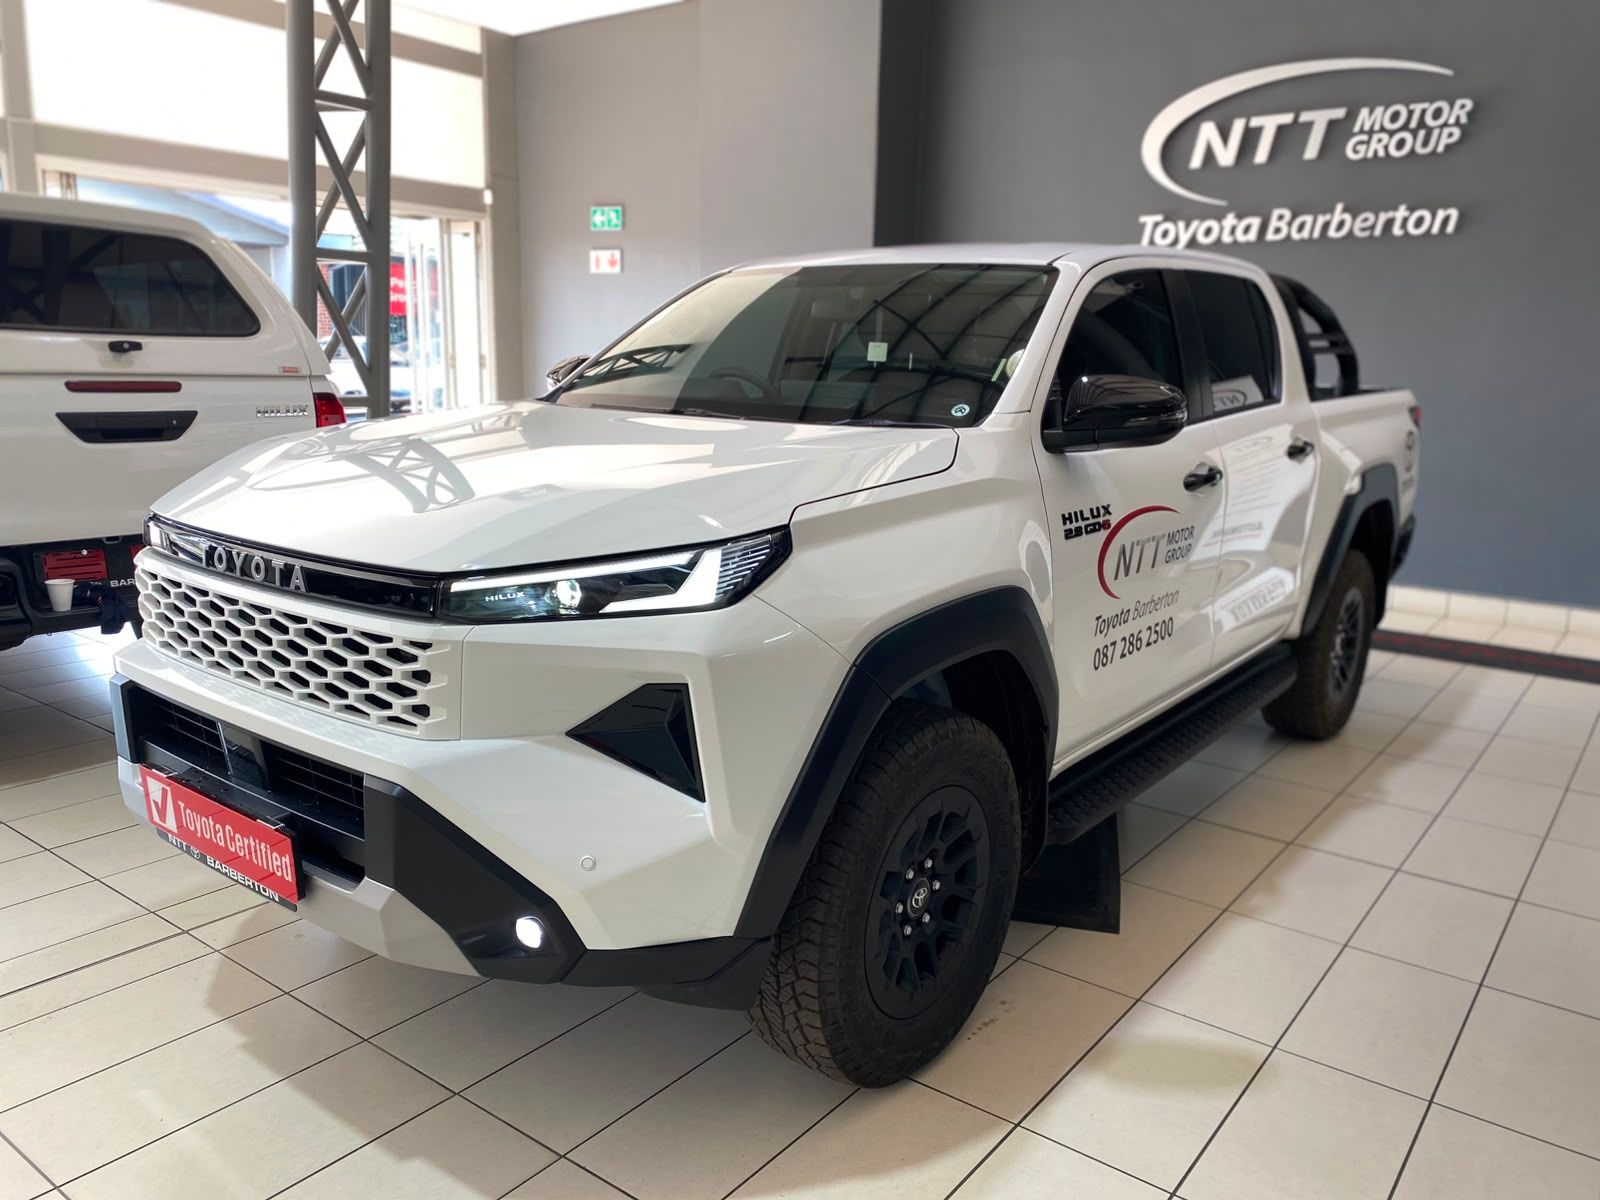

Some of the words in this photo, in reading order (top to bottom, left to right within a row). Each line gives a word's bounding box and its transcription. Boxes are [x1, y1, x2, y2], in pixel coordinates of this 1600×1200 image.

[1188, 107, 1347, 170] NTT
[1353, 98, 1473, 132] MOTOR
[1345, 126, 1462, 161] GROUP
[1138, 214, 1261, 250] Toyota
[1265, 203, 1460, 242] Barberton
[1061, 503, 1112, 526] HILUX
[1166, 526, 1195, 546] MOTOR
[200, 543, 306, 592] TOYOTA
[1114, 533, 1167, 580] NTT
[1164, 543, 1192, 563] GROUP
[485, 592, 525, 601] HILUX
[1094, 608, 1131, 638] Toyota
[1132, 590, 1179, 621] Barberton
[1093, 641, 1118, 672] 087
[1119, 630, 1144, 659] 286
[1145, 616, 1175, 648] 2500
[177, 800, 226, 848] Toyota
[224, 824, 293, 883] Certified
[206, 854, 280, 903] BARBERTON
